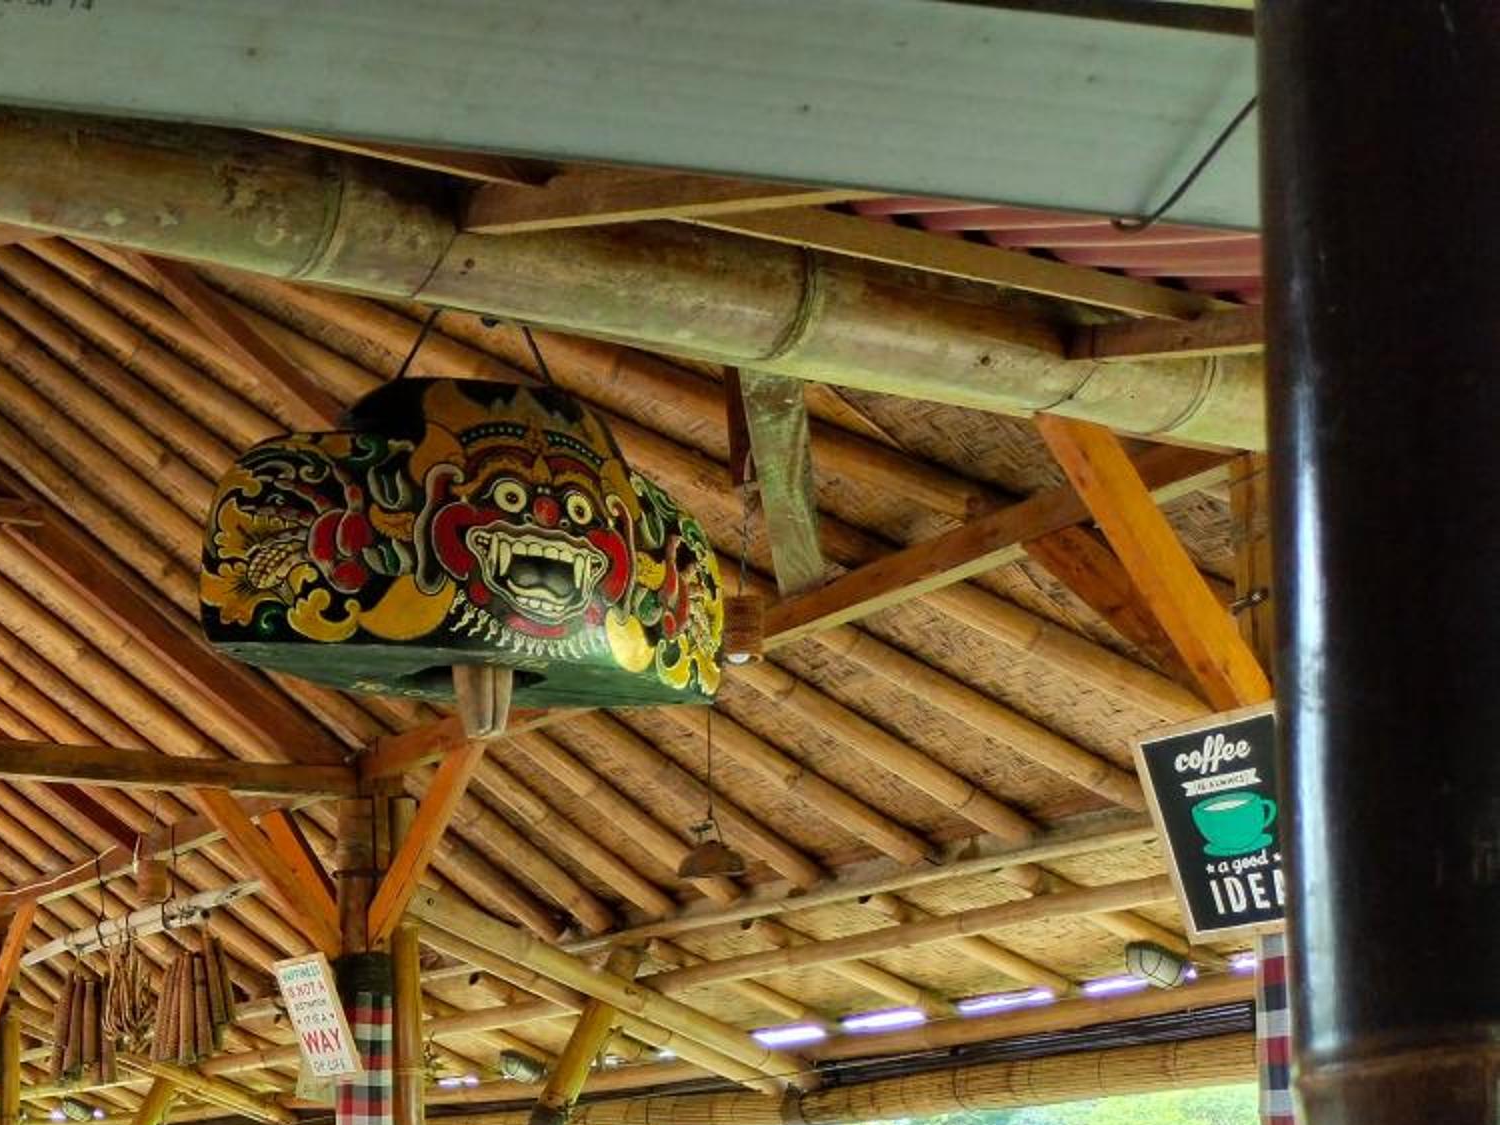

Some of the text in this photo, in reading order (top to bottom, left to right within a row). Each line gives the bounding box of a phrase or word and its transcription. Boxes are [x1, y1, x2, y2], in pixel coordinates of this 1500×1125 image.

[1174, 733, 1251, 775] coffee
[1217, 849, 1268, 875] a good
[301, 1027, 343, 1055] WAY
